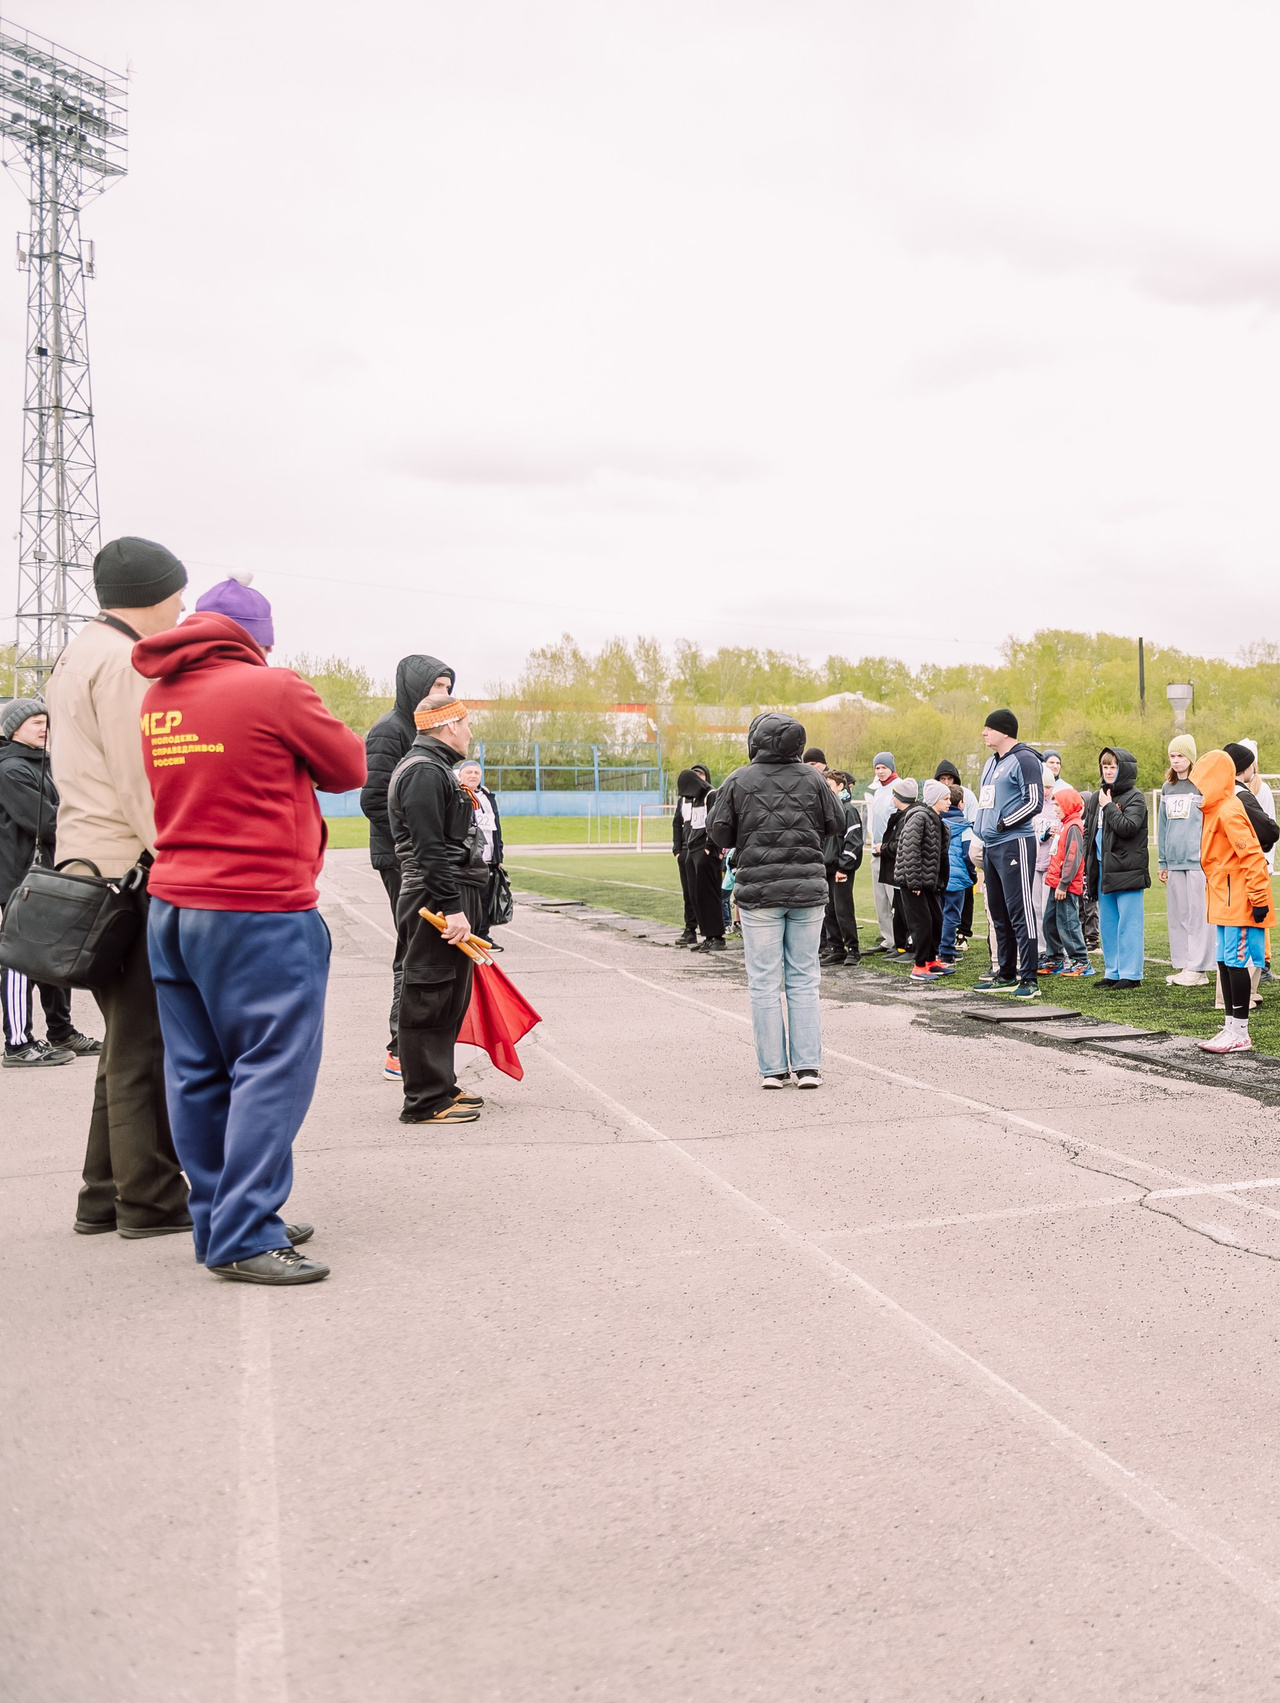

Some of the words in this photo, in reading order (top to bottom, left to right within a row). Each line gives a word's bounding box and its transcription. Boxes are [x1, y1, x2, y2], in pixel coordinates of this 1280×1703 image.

[152, 744, 224, 756] СПРАВЕДЛИВОЙ
[153, 757, 186, 767] РОССИИ
[1172, 799, 1185, 814] 19
[477, 814, 491, 827] 22
